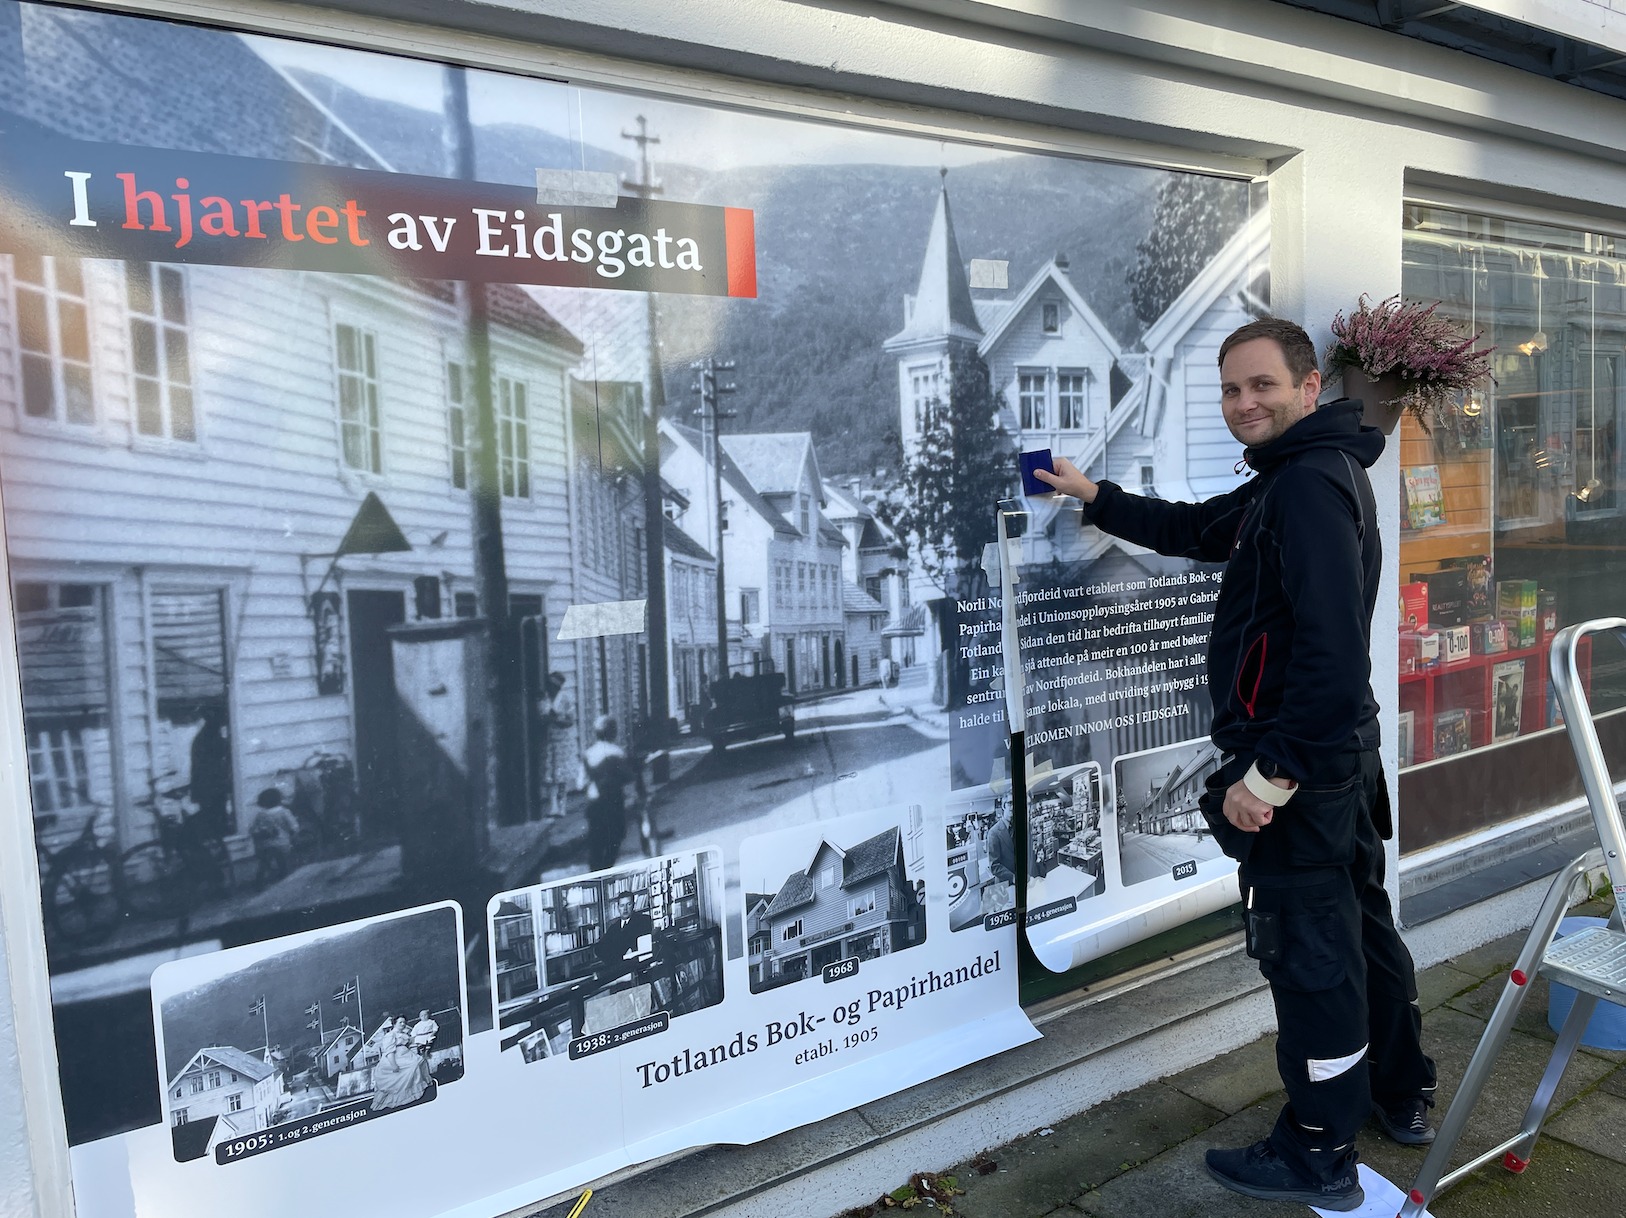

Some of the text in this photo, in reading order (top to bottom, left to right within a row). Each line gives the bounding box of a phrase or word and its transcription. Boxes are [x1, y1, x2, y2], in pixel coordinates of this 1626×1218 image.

[64, 171, 703, 278] I hjartet av Eidsgata
[957, 598, 986, 613] Norli
[1063, 585, 1084, 598] vart
[1086, 581, 1124, 595] etablert
[1126, 580, 1146, 591] som
[1148, 573, 1187, 588] Totlands
[1189, 571, 1210, 584] Bok-
[1212, 571, 1223, 583] og
[1033, 612, 1037, 625] i
[1039, 599, 1153, 623] Unionsoppløysingsåret
[1154, 597, 1176, 609] 1905
[1178, 596, 1188, 606] av
[1020, 635, 1043, 650] Sidan
[1046, 632, 1065, 645] den
[1067, 629, 1081, 642] tid
[1084, 628, 1101, 640] har
[1103, 622, 1141, 637] bedrifta
[1143, 616, 1179, 631] tilhøyrt
[1449, 634, 1468, 653] 0-100
[971, 667, 989, 680] Ein
[1025, 657, 1036, 674] sjå
[1037, 652, 1075, 669] attende
[1077, 649, 1089, 666] på
[1091, 646, 1114, 661] meir
[1116, 648, 1128, 657] en
[1130, 642, 1147, 654] 100
[1149, 639, 1159, 651] år
[1161, 635, 1180, 650] med
[1182, 633, 1208, 647] bøker
[1026, 684, 1034, 695] av
[1036, 670, 1102, 692] Nordfjordeid.
[1105, 660, 1167, 680] Bokhandelen
[1168, 658, 1183, 670] har
[1185, 655, 1189, 666] i
[1190, 653, 1206, 665] alle
[959, 713, 990, 728] halde
[992, 709, 1004, 722] til
[1026, 704, 1046, 718] same
[1048, 697, 1082, 713] lokala,
[1085, 691, 1106, 706] med
[1108, 685, 1149, 701] utviding
[1151, 684, 1161, 694] av
[1163, 678, 1194, 693] nybygg
[1196, 674, 1199, 685] i
[1075, 719, 1113, 736] INNOM
[1115, 714, 1134, 728] OSS
[1136, 712, 1140, 724] I
[1141, 703, 1189, 723] EIDSGATA
[1175, 863, 1193, 876] 2015
[990, 911, 1012, 926] 1976:
[829, 961, 853, 978] 1968
[636, 950, 1001, 1089] Totlands Bok- og Papirhandel
[575, 1034, 611, 1054] 1938:
[794, 1026, 878, 1065] etabl. 1905
[225, 1132, 274, 1158] 1905:
[1320, 1176, 1353, 1192] HOKA
